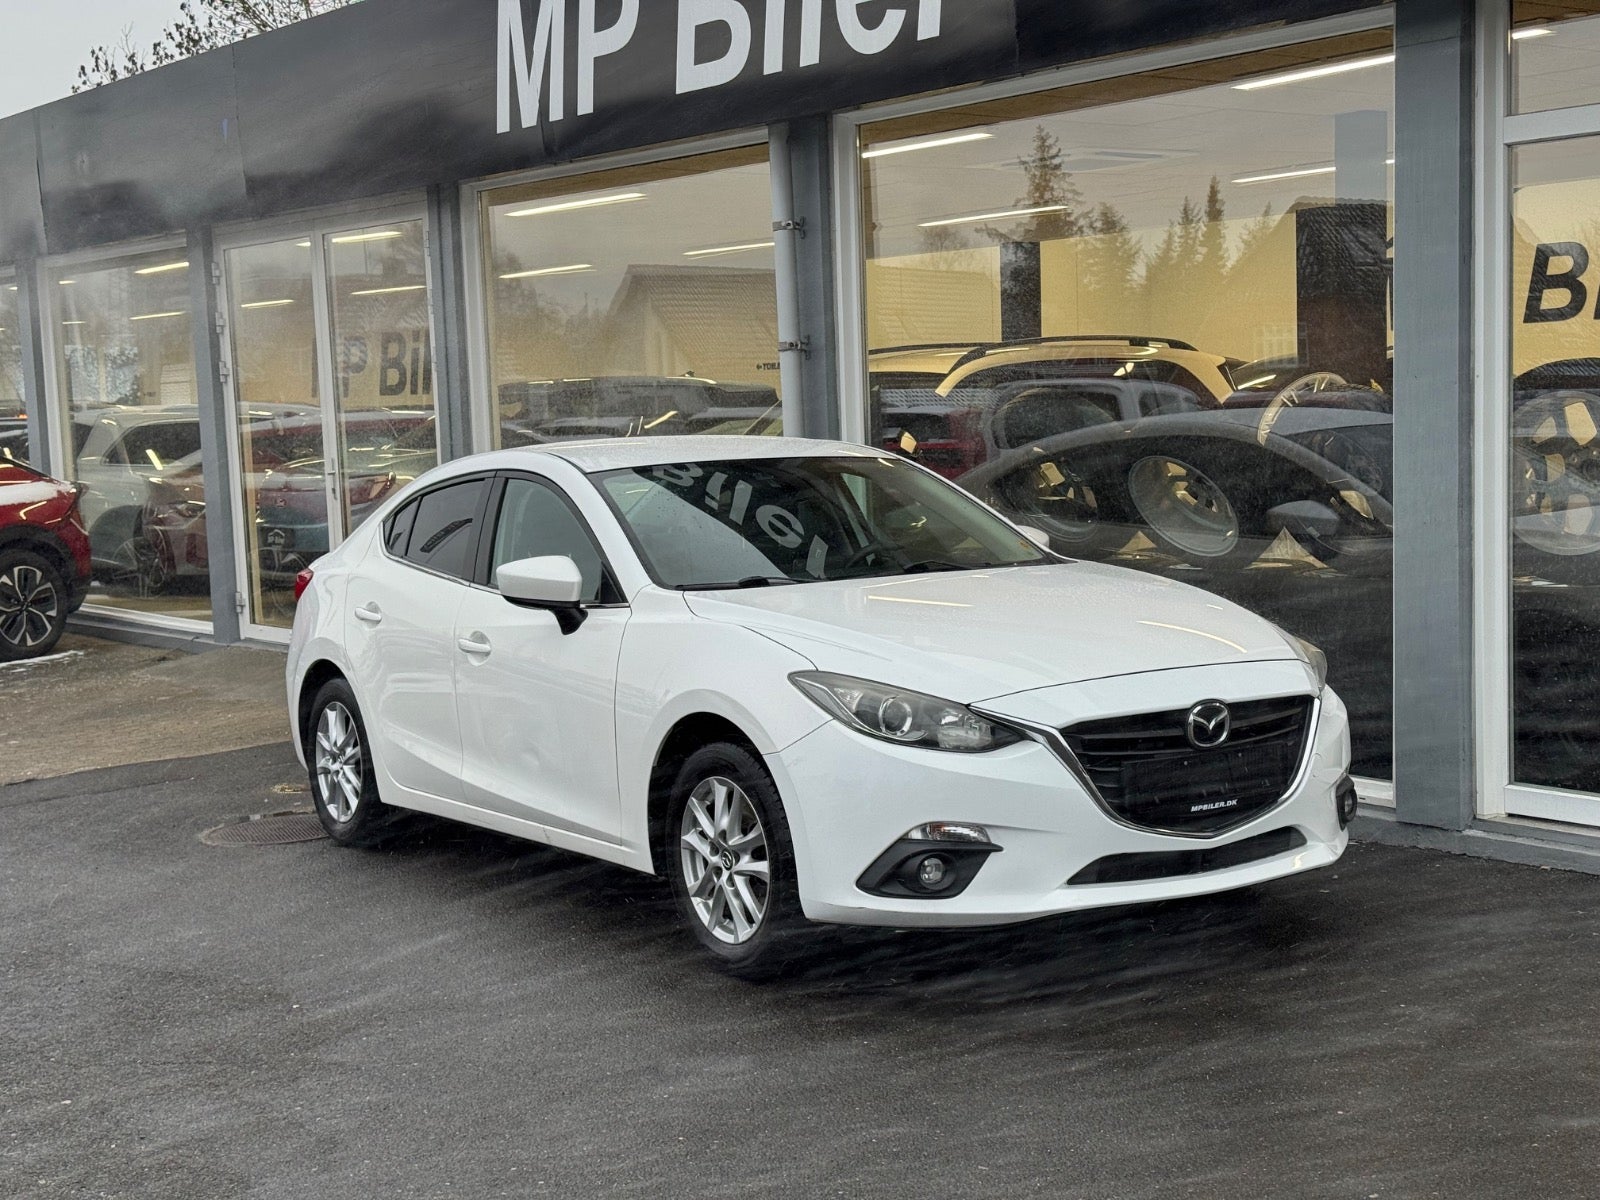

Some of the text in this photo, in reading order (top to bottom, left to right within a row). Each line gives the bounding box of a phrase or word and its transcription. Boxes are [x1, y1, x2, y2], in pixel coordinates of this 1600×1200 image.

[497, 0, 640, 134] MP
[1523, 242, 1600, 323] B
[1190, 799, 1238, 812] MPBILER.DK
